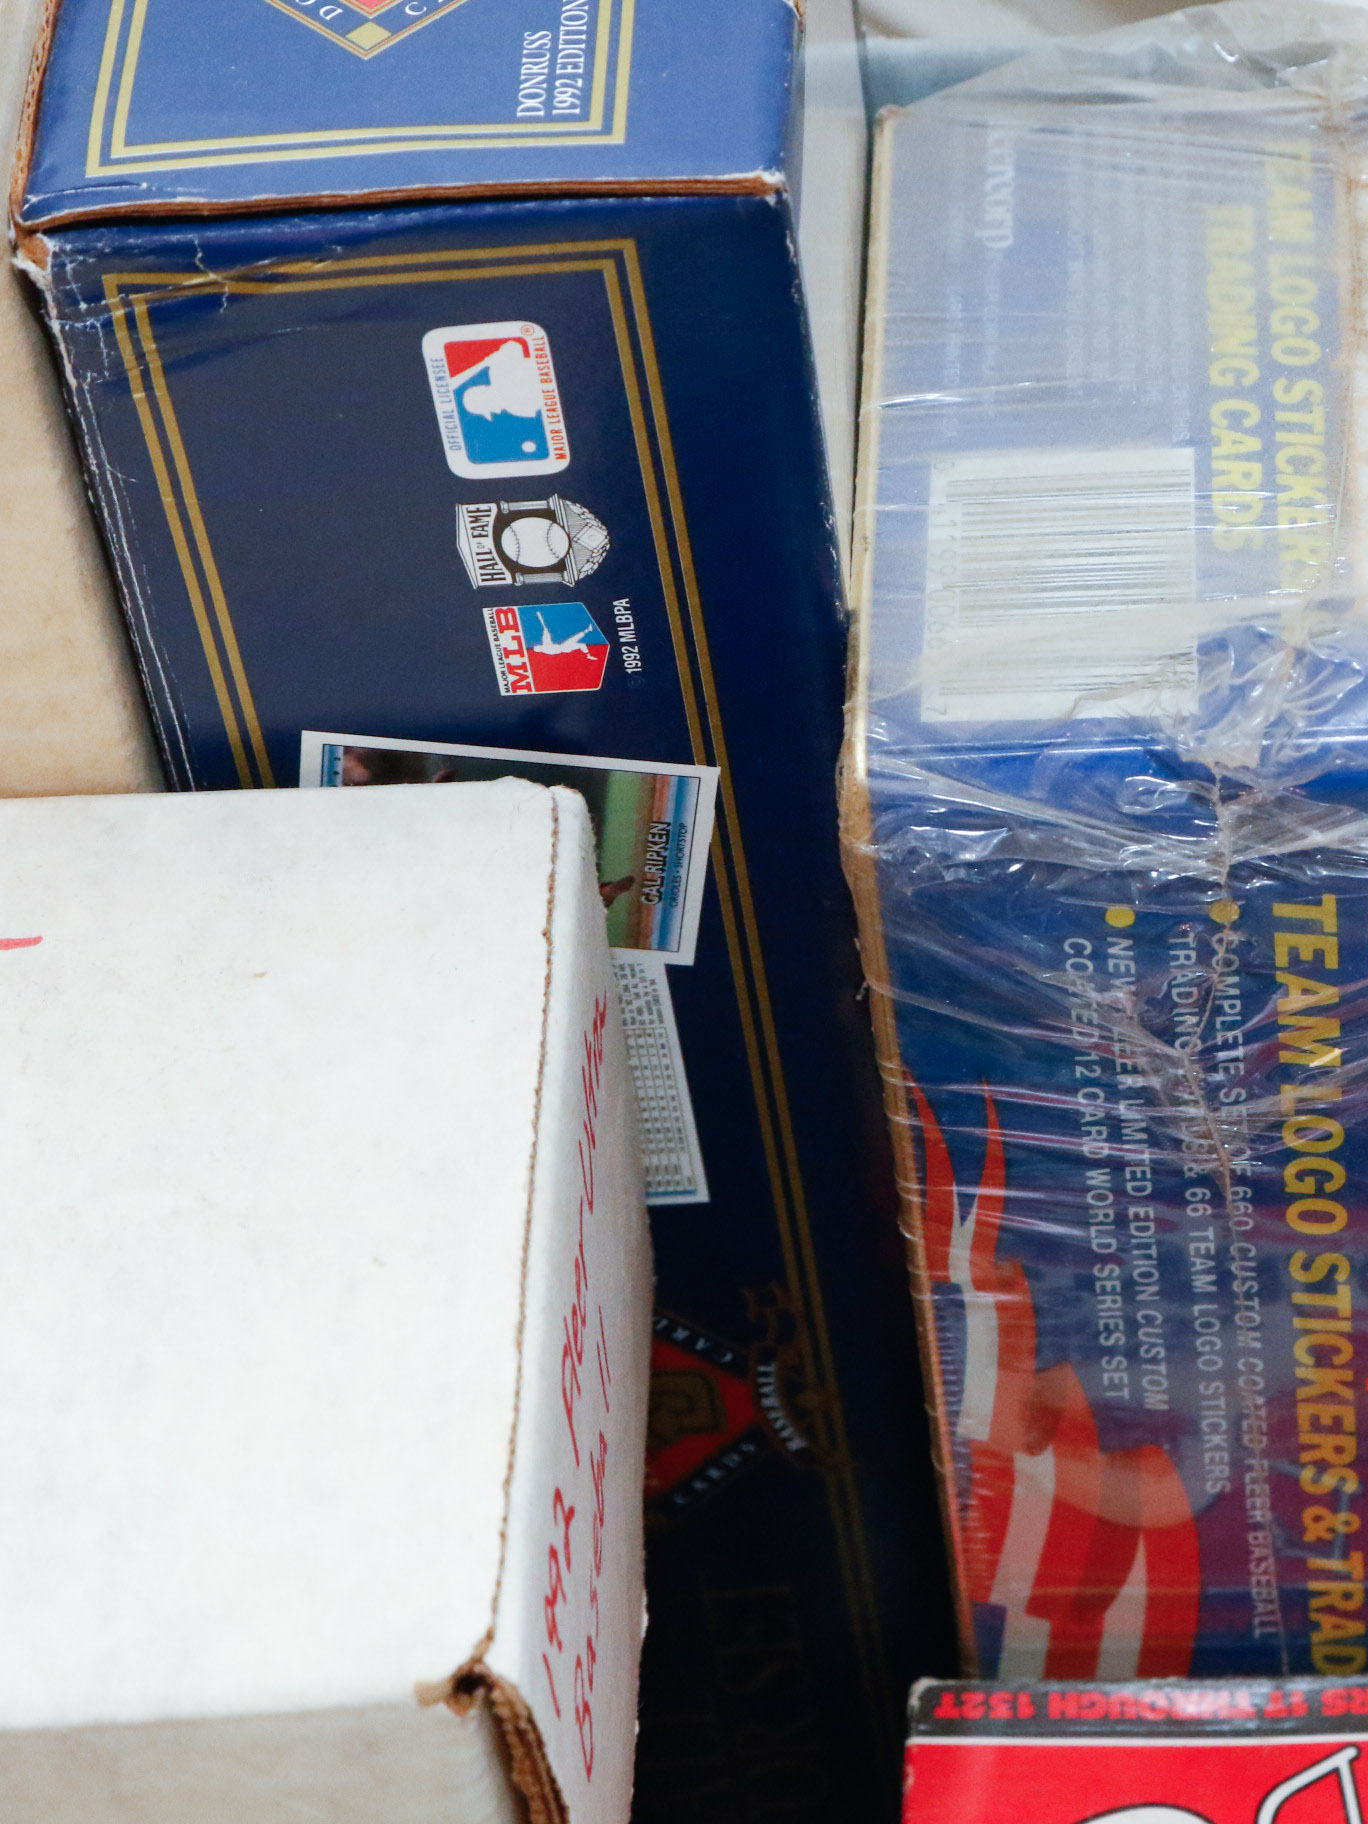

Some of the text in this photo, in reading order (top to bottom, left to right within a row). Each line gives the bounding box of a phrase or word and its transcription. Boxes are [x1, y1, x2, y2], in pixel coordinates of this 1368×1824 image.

[516, 30, 552, 118] DONRUSS
[552, 0, 590, 116] 1992 EDITION
[430, 357, 462, 451] OFFICIAL LICENSEE
[535, 336, 568, 460] MAJOR LEAGUE BASEBALL
[1205, 203, 1265, 552] TRADING CARDS
[1264, 139, 1328, 594] TEAM LOGO STICKERS
[466, 506, 493, 538] FAME
[476, 549, 507, 583] HALL
[489, 608, 513, 694] MAJOR LEAGUE BASEBALL
[495, 607, 533, 694] MLB
[613, 598, 642, 674] 1992 MLBPA
[640, 821, 671, 905] CAL RIPKEN
[674, 822, 688, 869] SHORTSTOP
[1169, 933, 1200, 1052] TRADING
[1209, 932, 1245, 1085] COMPLETE
[1272, 894, 1341, 1068] TEAM
[1075, 1050, 1101, 1079] 12
[1077, 1087, 1109, 1159] CARD
[1119, 1099, 1153, 1198] LIMITED
[1280, 1085, 1348, 1235] LOGO
[1086, 1168, 1117, 1254] WORLD
[1185, 1187, 1211, 1217] 66
[1229, 1185, 1253, 1232] 660
[1128, 1207, 1160, 1301] EDITION
[1188, 1228, 1218, 1294] TEAM
[1230, 1242, 1261, 1349] CUSTOM
[1093, 1263, 1125, 1347] SERIES
[1193, 1304, 1224, 1372] LOGO
[1102, 1355, 1129, 1401] SET
[1136, 1310, 1169, 1412] CUSTOM
[1289, 1250, 1361, 1493] STICKERS
[1198, 1382, 1231, 1495] STICKERS
[571, 1305, 611, 1784] Baseball
[1302, 1506, 1361, 1542] &
[541, 1487, 576, 1718] 1992
[1248, 1527, 1280, 1640] BASEBALL
[1307, 1551, 1368, 1676] TRAD
[935, 1690, 1034, 1720] 132T
[1050, 1690, 1256, 1722] THROUGH
[1263, 1689, 1312, 1720] 1T
